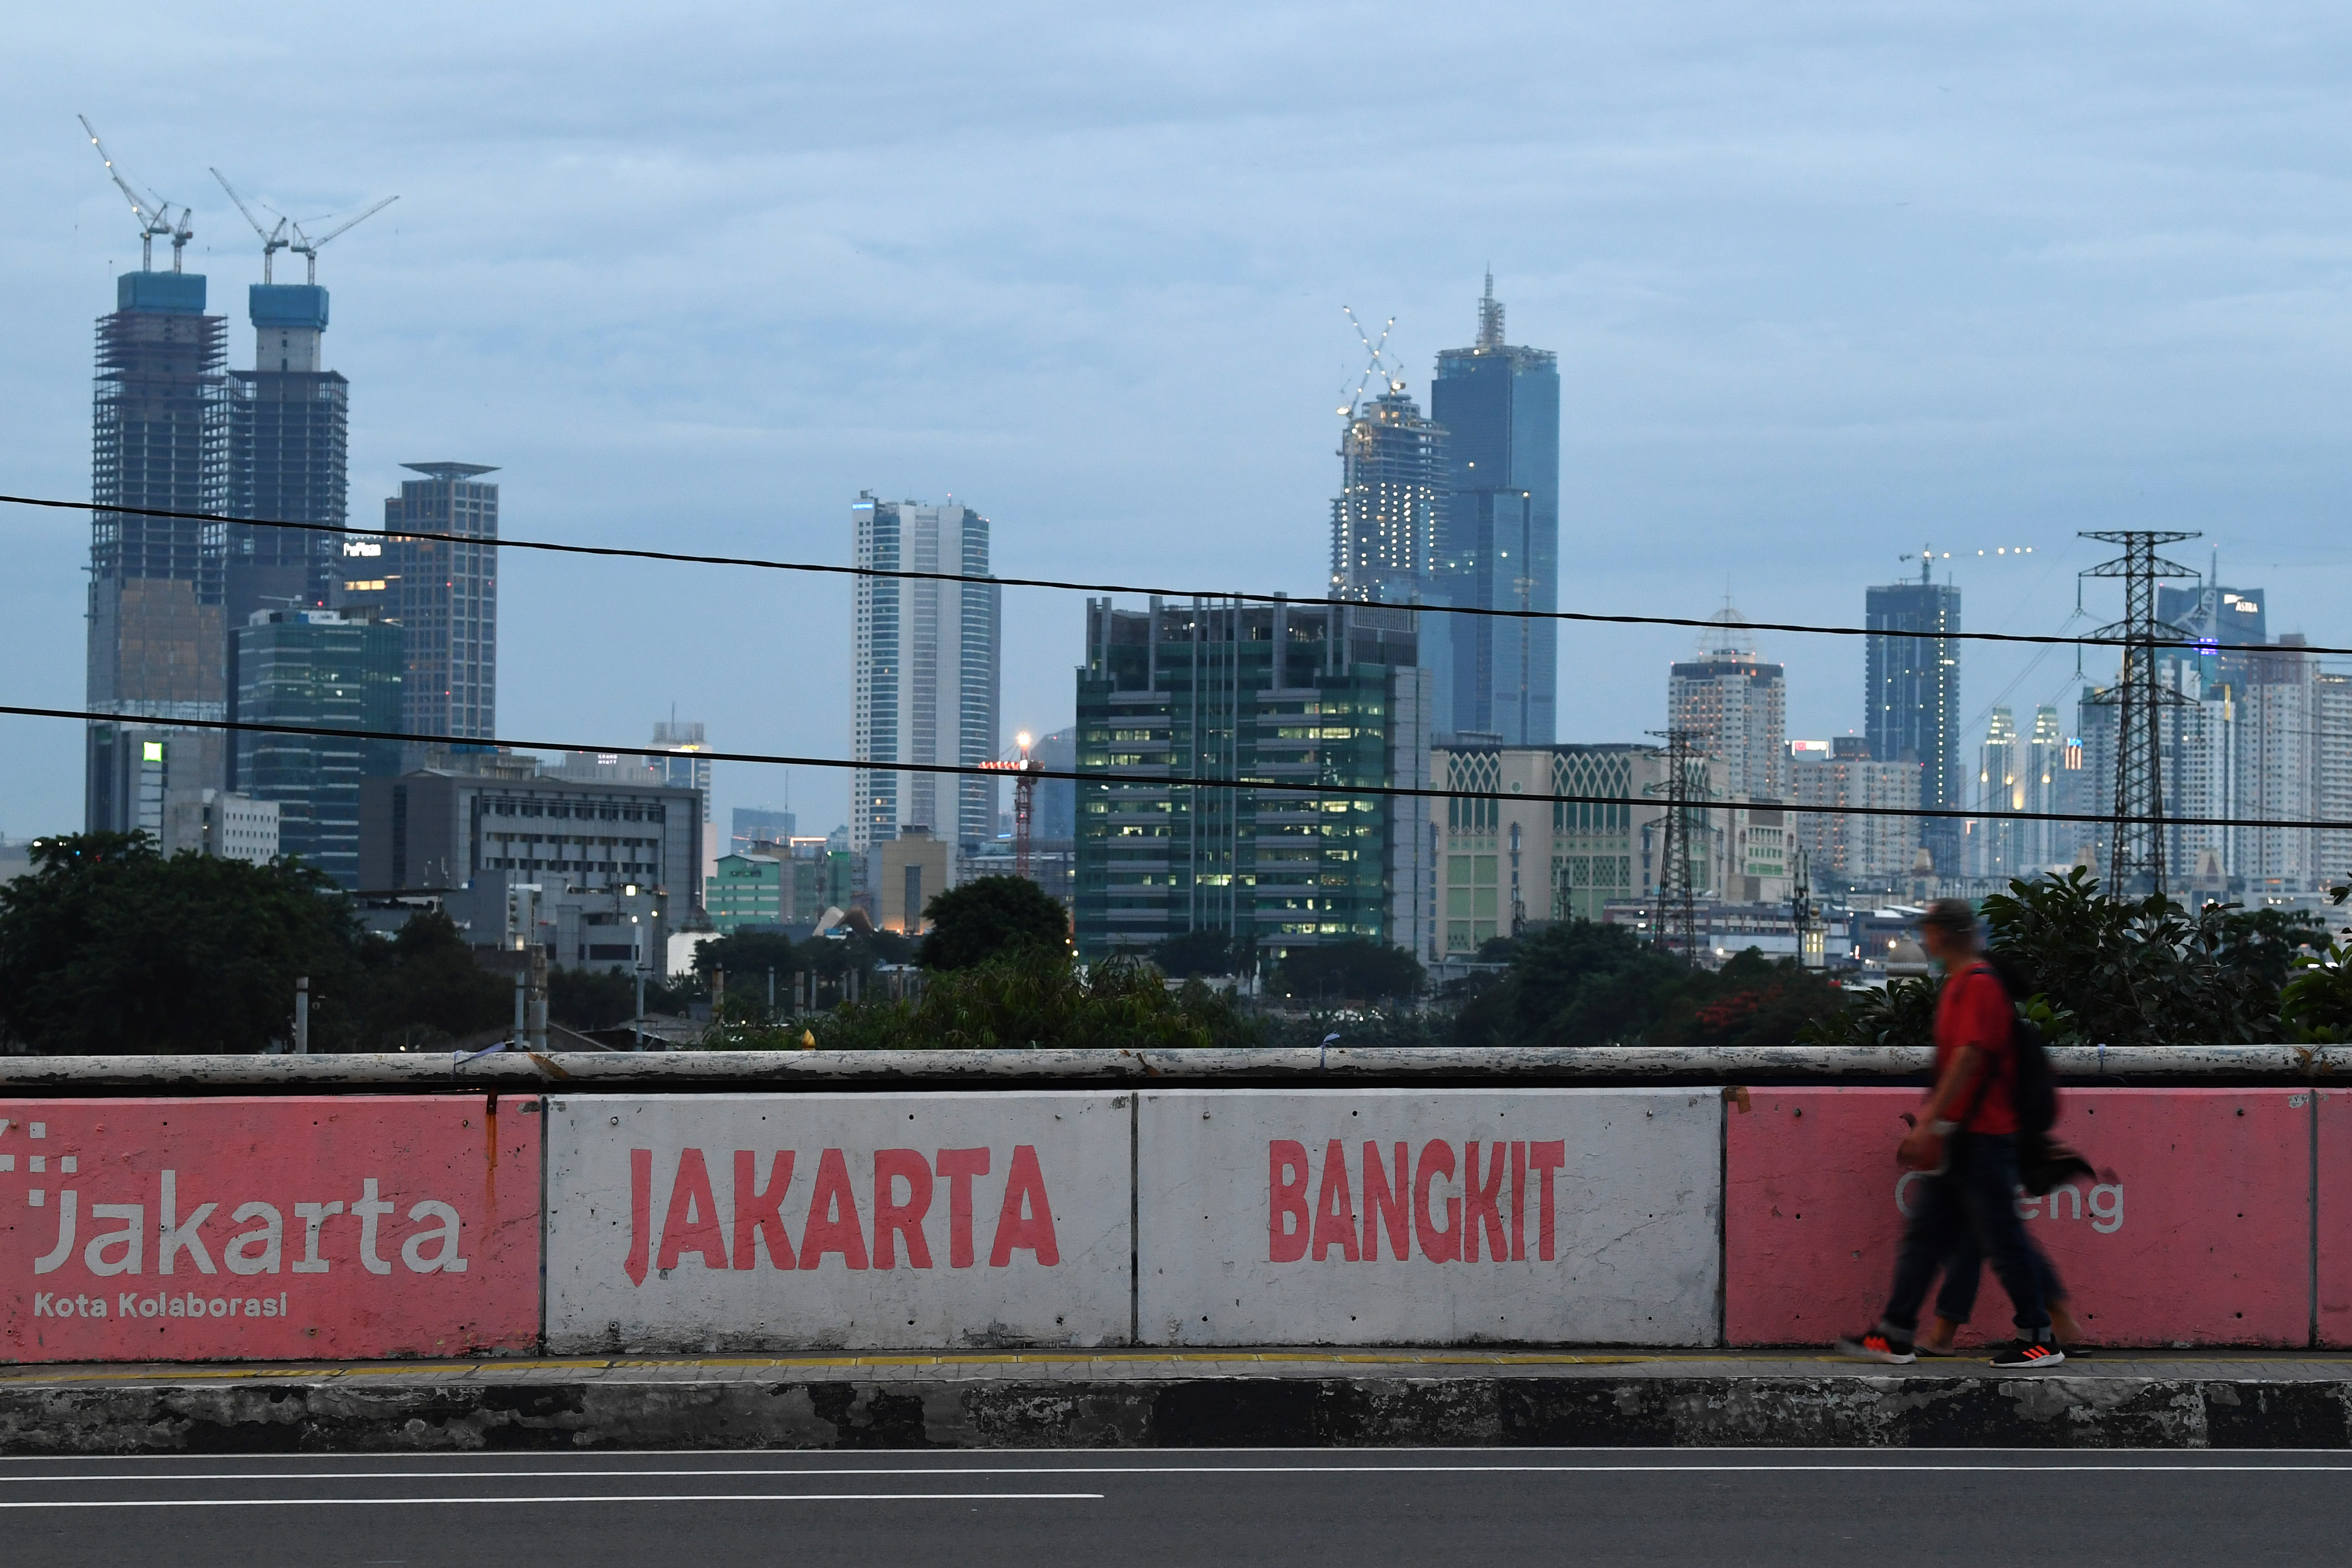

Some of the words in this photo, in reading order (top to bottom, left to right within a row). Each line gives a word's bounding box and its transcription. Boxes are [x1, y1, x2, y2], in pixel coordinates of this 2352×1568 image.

[2235, 601, 2258, 613] ASTRA
[623, 1145, 1060, 1287] JAKARTA
[1269, 1138, 1564, 1264] BANGKIT
[35, 1292, 107, 1317] Kota
[119, 1292, 287, 1317] Kolaborasi
